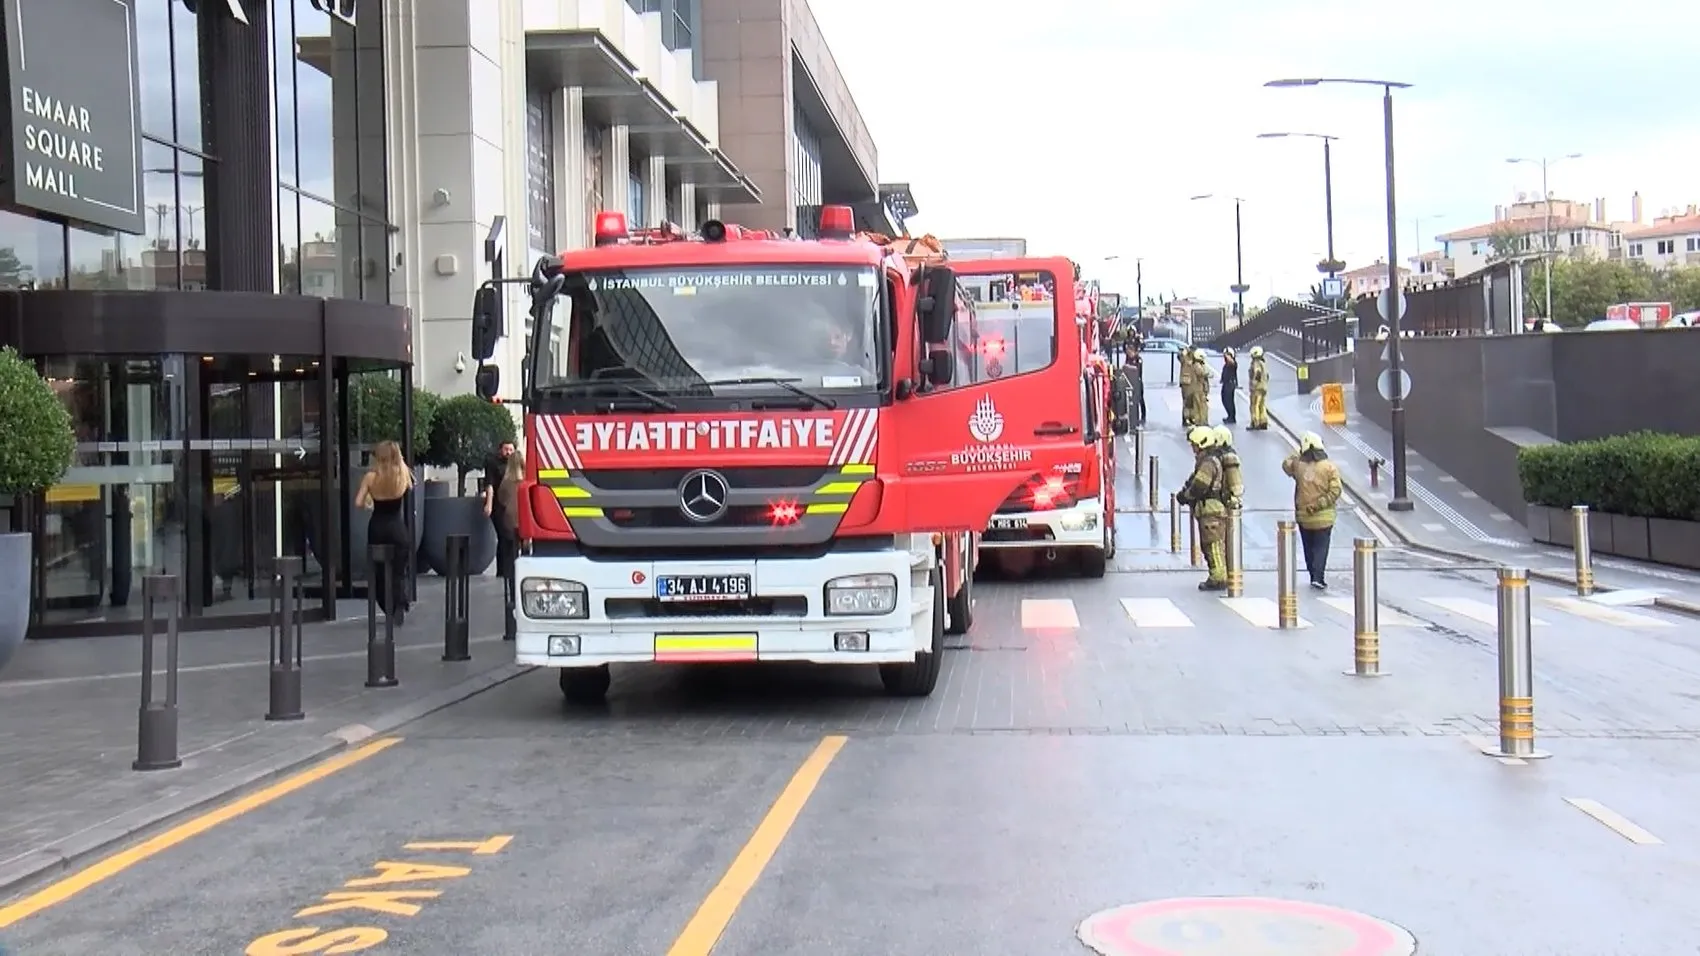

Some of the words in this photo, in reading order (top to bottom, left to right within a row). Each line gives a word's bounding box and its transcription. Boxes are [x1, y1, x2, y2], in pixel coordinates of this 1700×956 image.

[22, 86, 91, 133] EMAAR
[25, 124, 103, 172] SQUARE
[26, 162, 78, 199] MALL
[603, 277, 665, 290] İSTANBUL
[668, 272, 753, 288] BÜYÜKŞEHİR
[756, 272, 832, 286] BELEDİYESİ
[668, 578, 684, 594] 34
[690, 577, 707, 594] AJ
[712, 577, 747, 594] 4196
